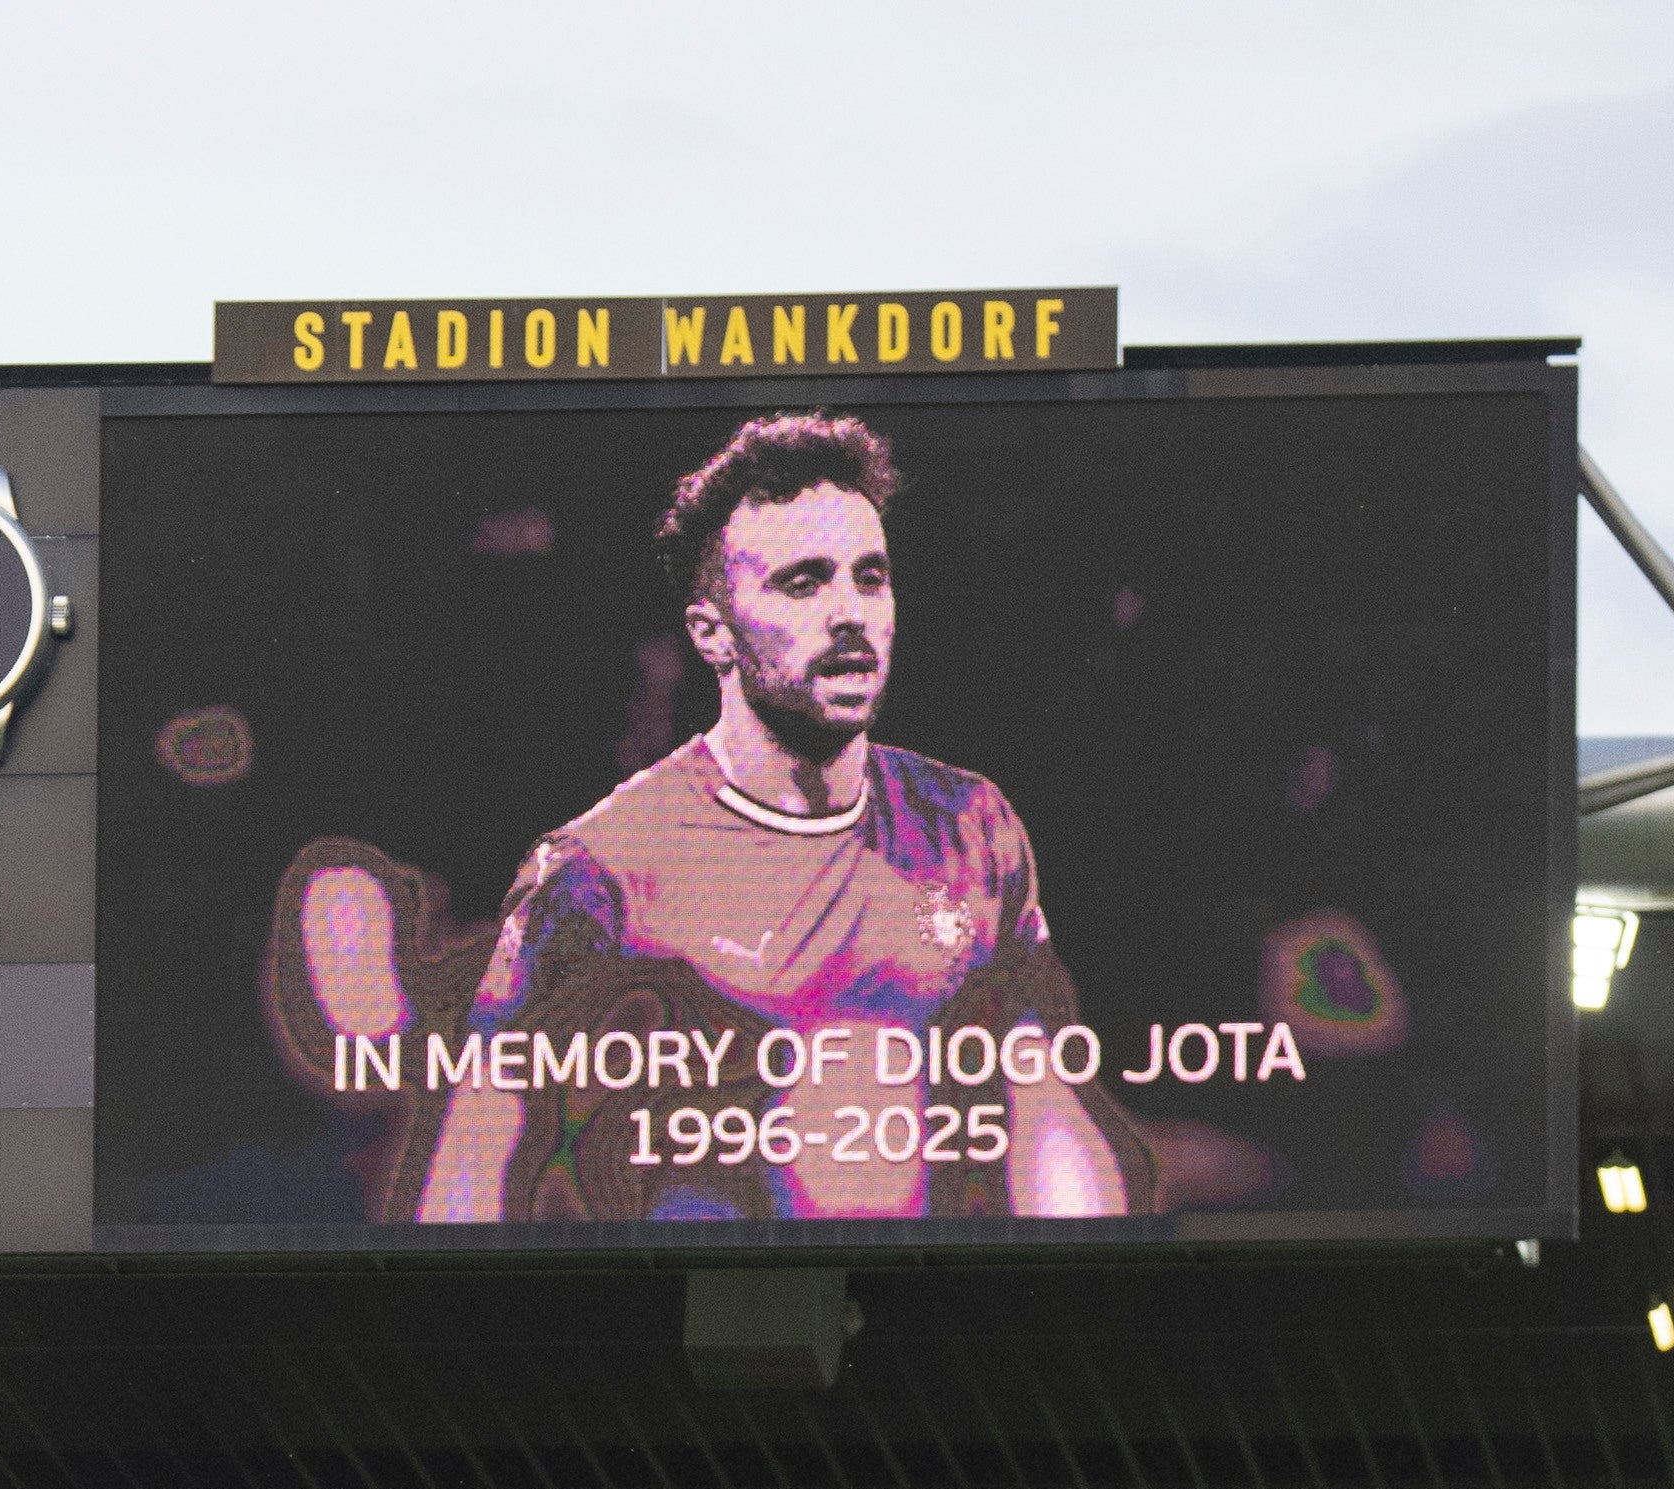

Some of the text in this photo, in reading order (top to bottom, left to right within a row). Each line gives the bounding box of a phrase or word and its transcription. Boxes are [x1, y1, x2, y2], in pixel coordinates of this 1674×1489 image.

[293, 299, 1065, 372] STADION WANKDORF
[333, 1022, 1306, 1092] IN MEMORY OF DIOGO JOTA
[628, 1105, 1009, 1165] 1996-2025
